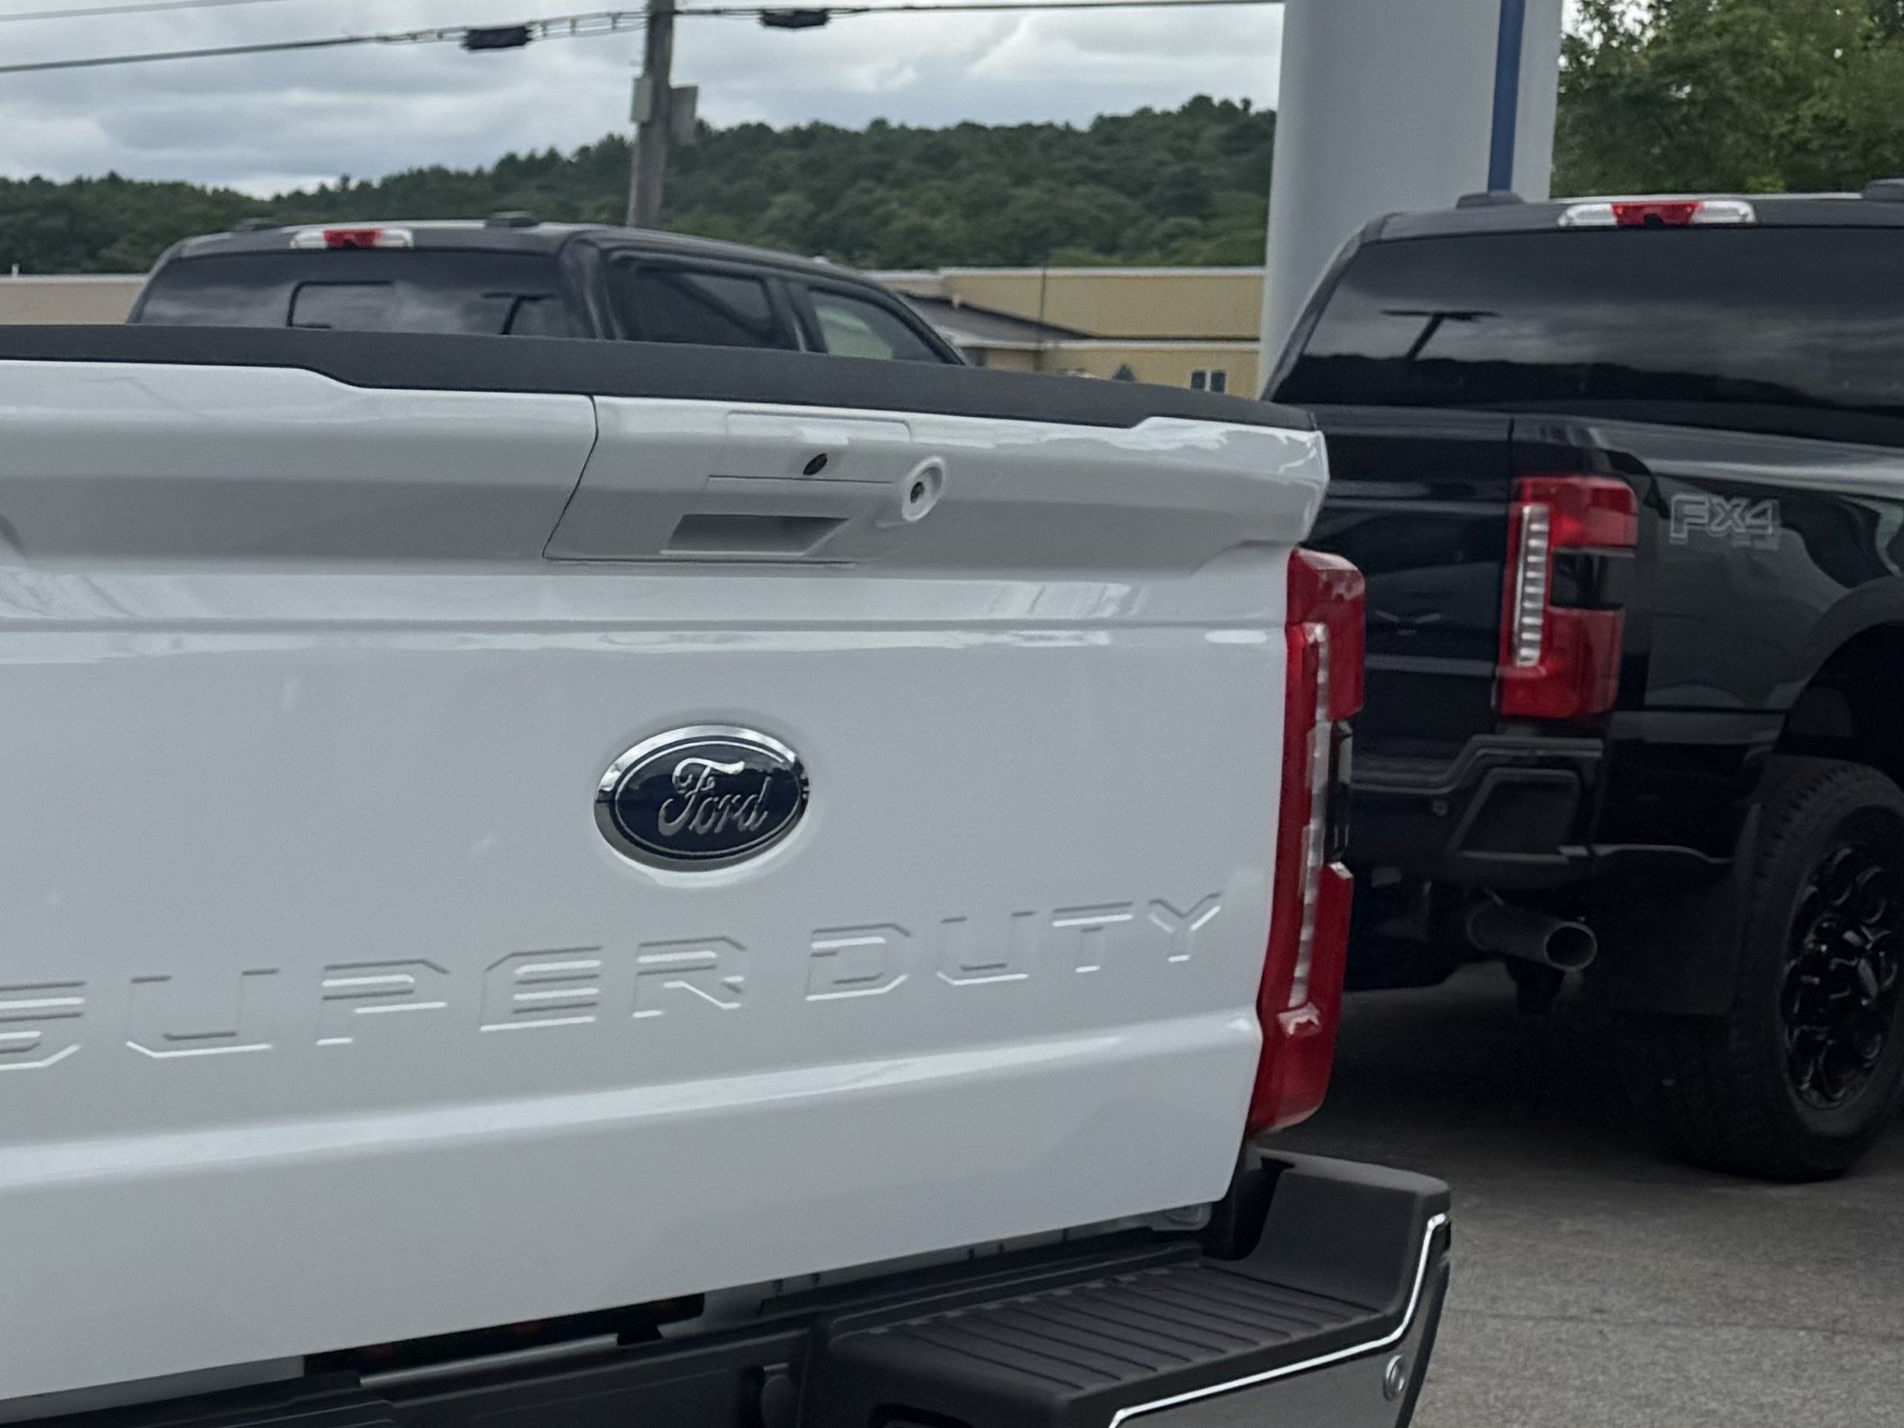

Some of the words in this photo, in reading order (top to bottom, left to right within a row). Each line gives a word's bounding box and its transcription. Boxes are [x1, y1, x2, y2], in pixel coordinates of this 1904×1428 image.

[1670, 494, 1779, 548] FX4
[658, 758, 772, 836] Ford
[805, 892, 1222, 1002] DUTY
